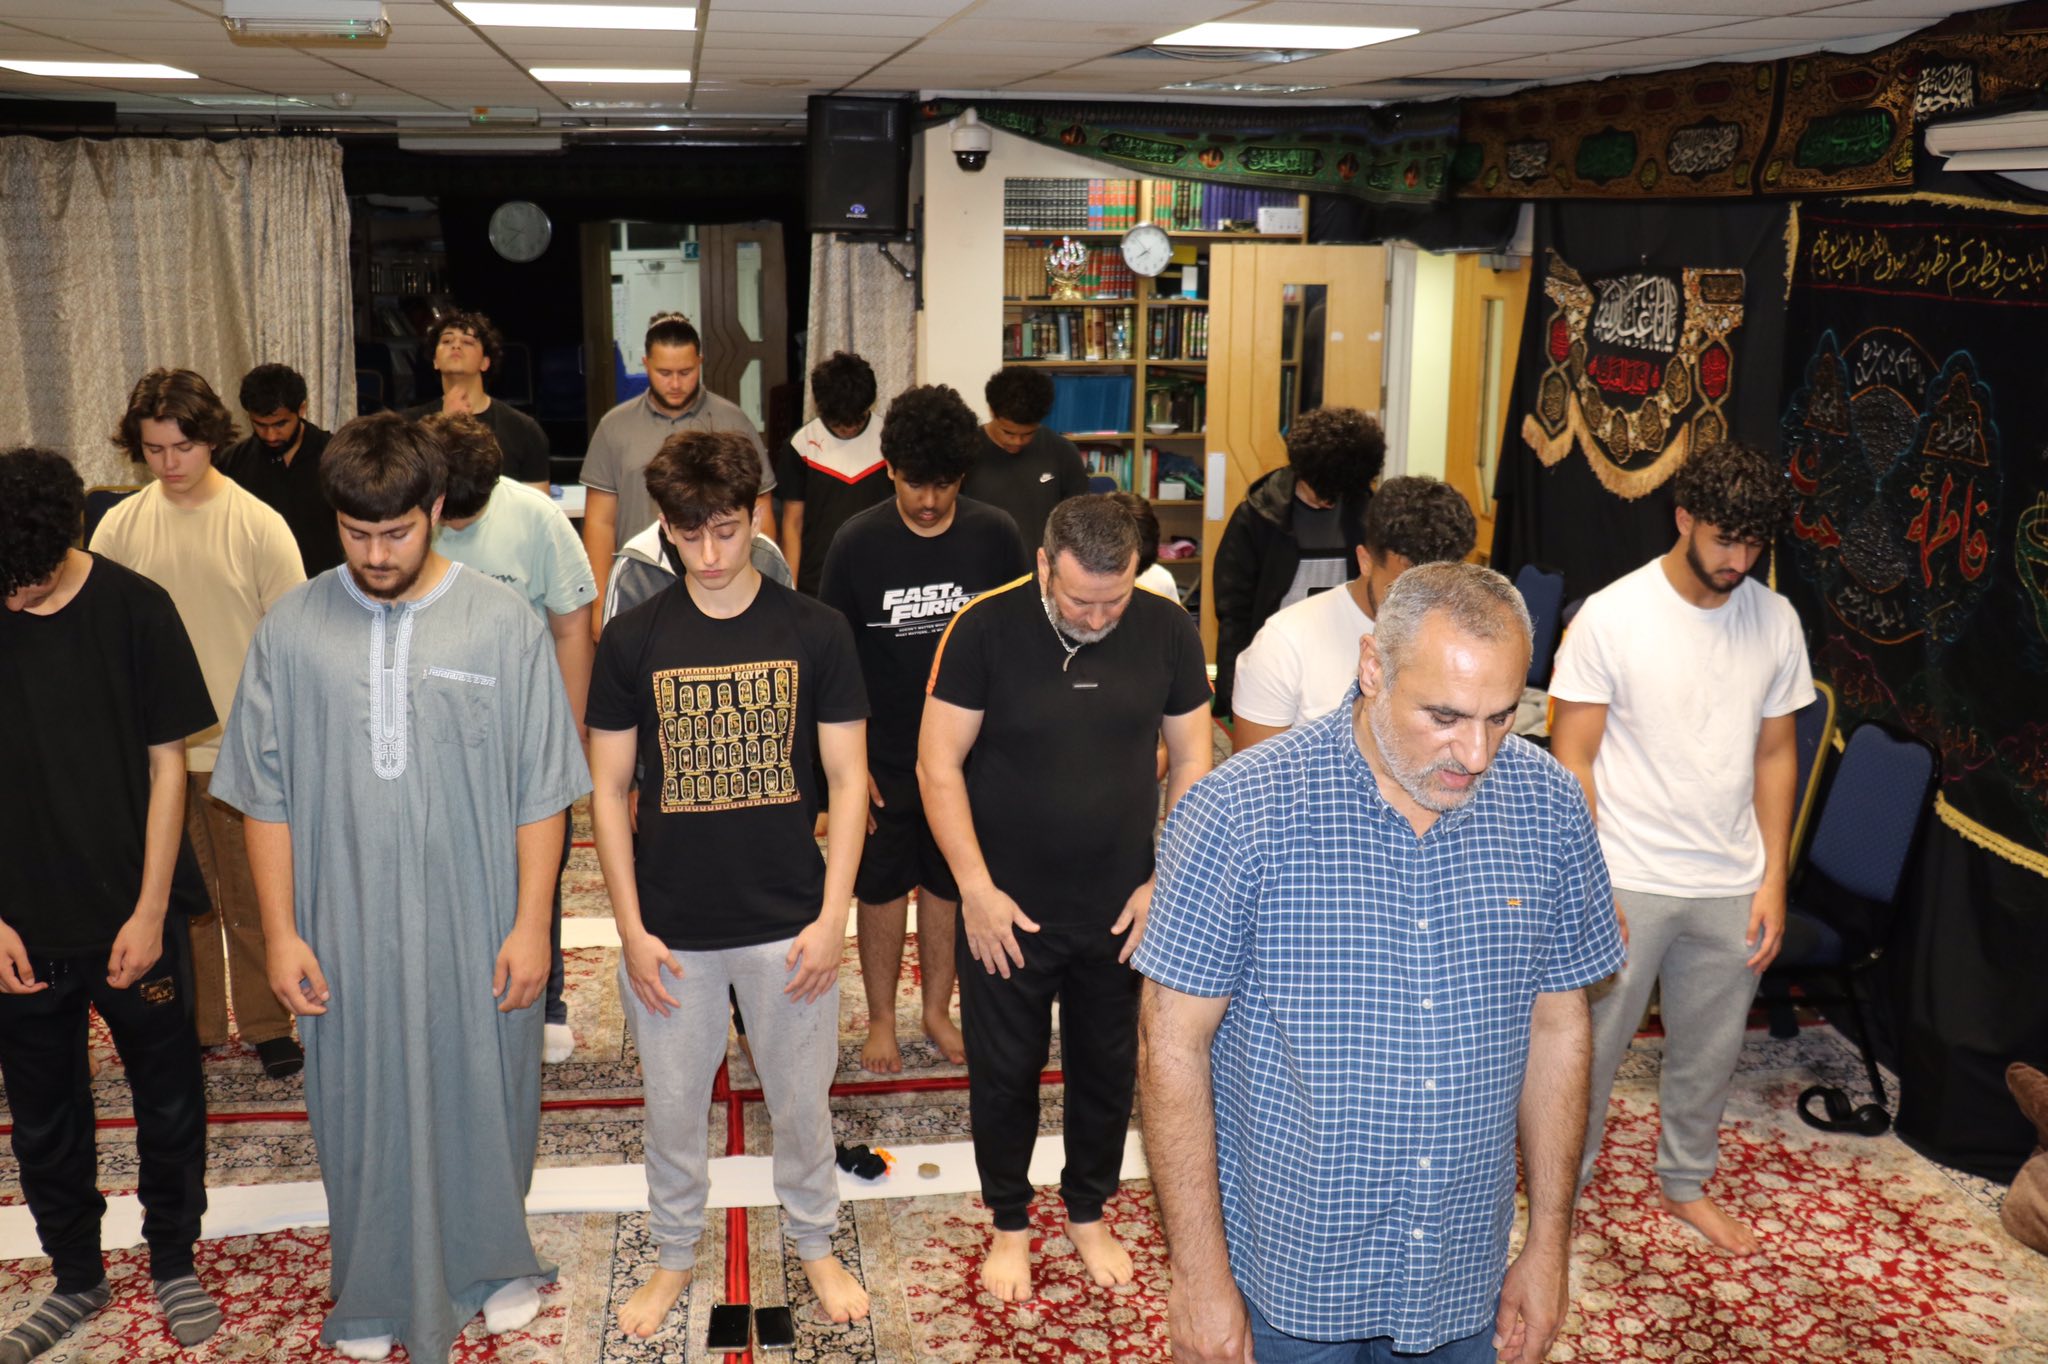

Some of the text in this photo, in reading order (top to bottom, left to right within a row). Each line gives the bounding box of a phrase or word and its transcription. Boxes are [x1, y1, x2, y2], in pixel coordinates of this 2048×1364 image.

[882, 582, 954, 611] FAST
[890, 596, 972, 625] FURIO
[734, 669, 769, 681] EGYPT
